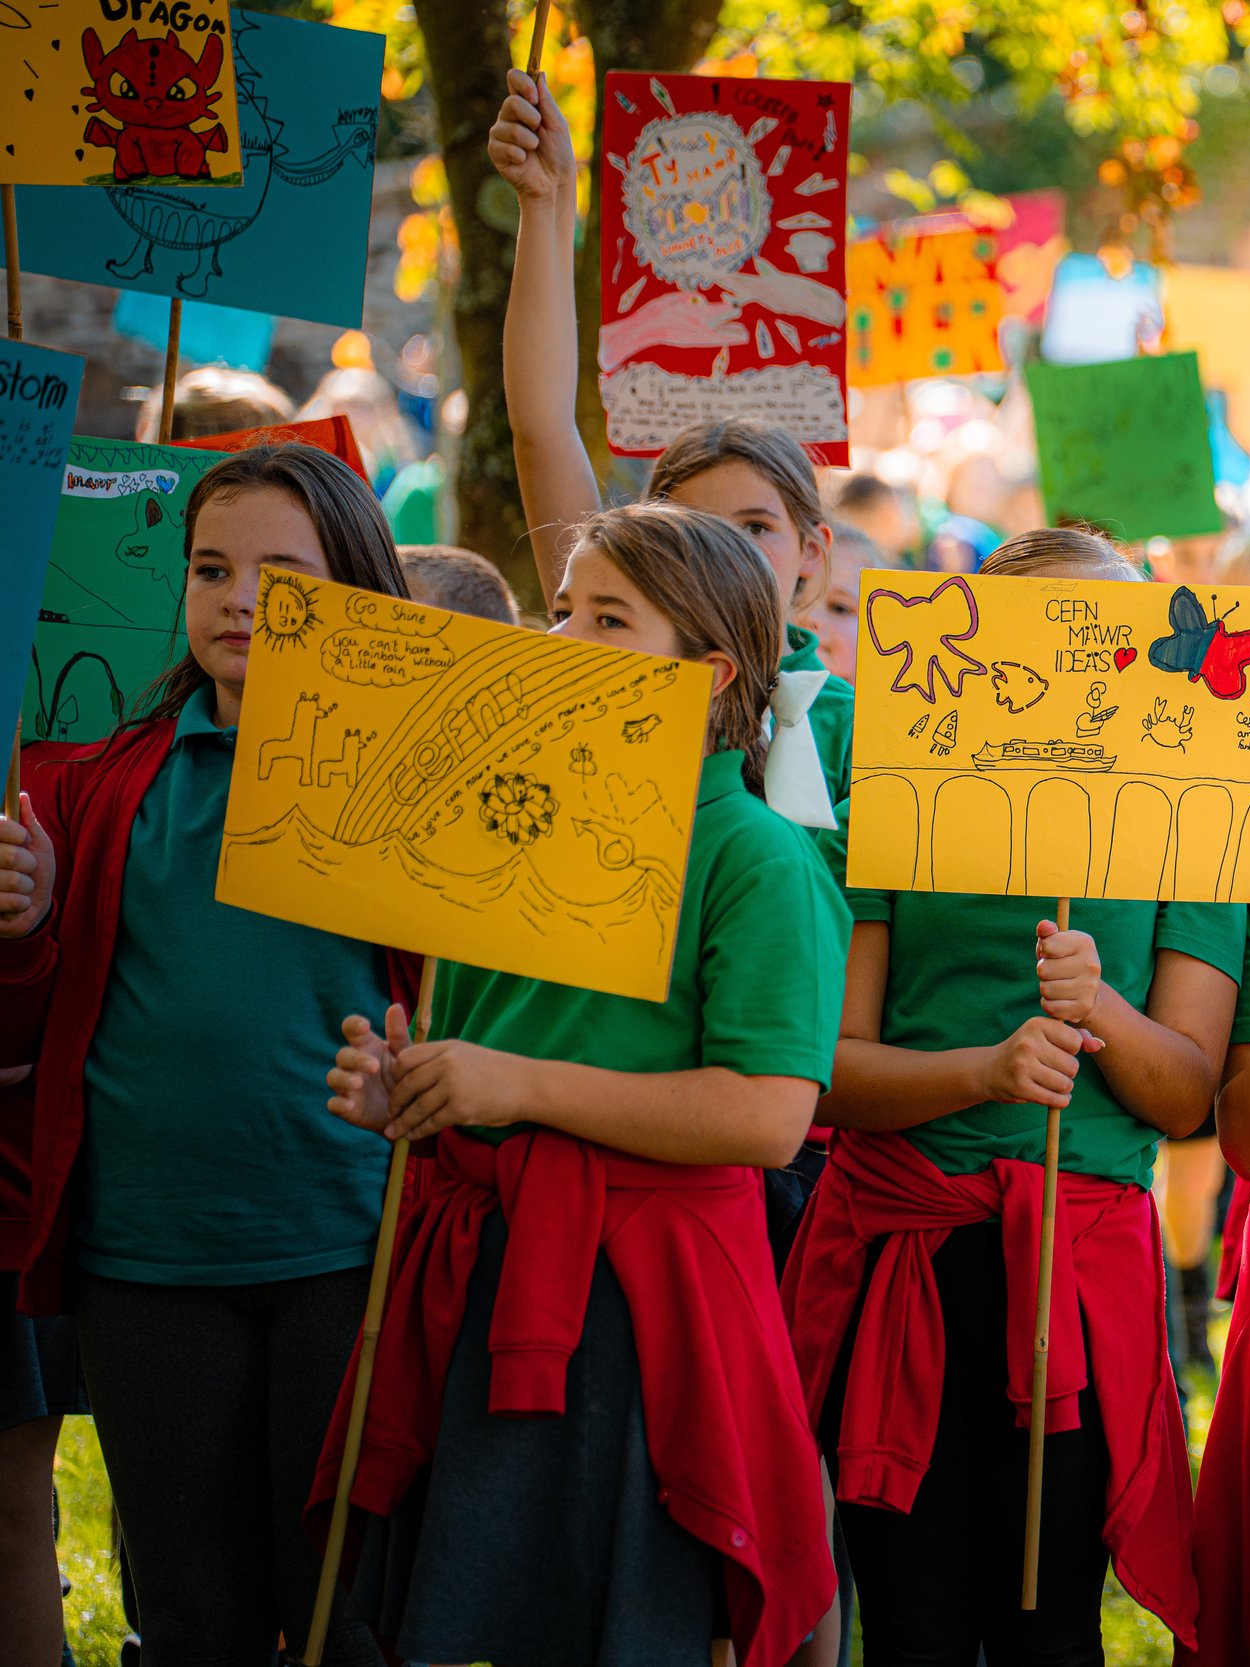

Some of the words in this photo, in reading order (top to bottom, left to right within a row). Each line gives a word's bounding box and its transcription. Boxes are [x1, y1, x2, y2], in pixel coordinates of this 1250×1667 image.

[354, 596, 377, 615] Go
[390, 604, 427, 625] Shine
[1045, 599, 1098, 622] CEFN
[329, 636, 359, 659] you
[369, 639, 399, 653] can't
[405, 641, 431, 655] have
[341, 647, 351, 657] a
[357, 648, 406, 662] rainbow
[334, 658, 344, 668] a
[382, 663, 406, 679] rain
